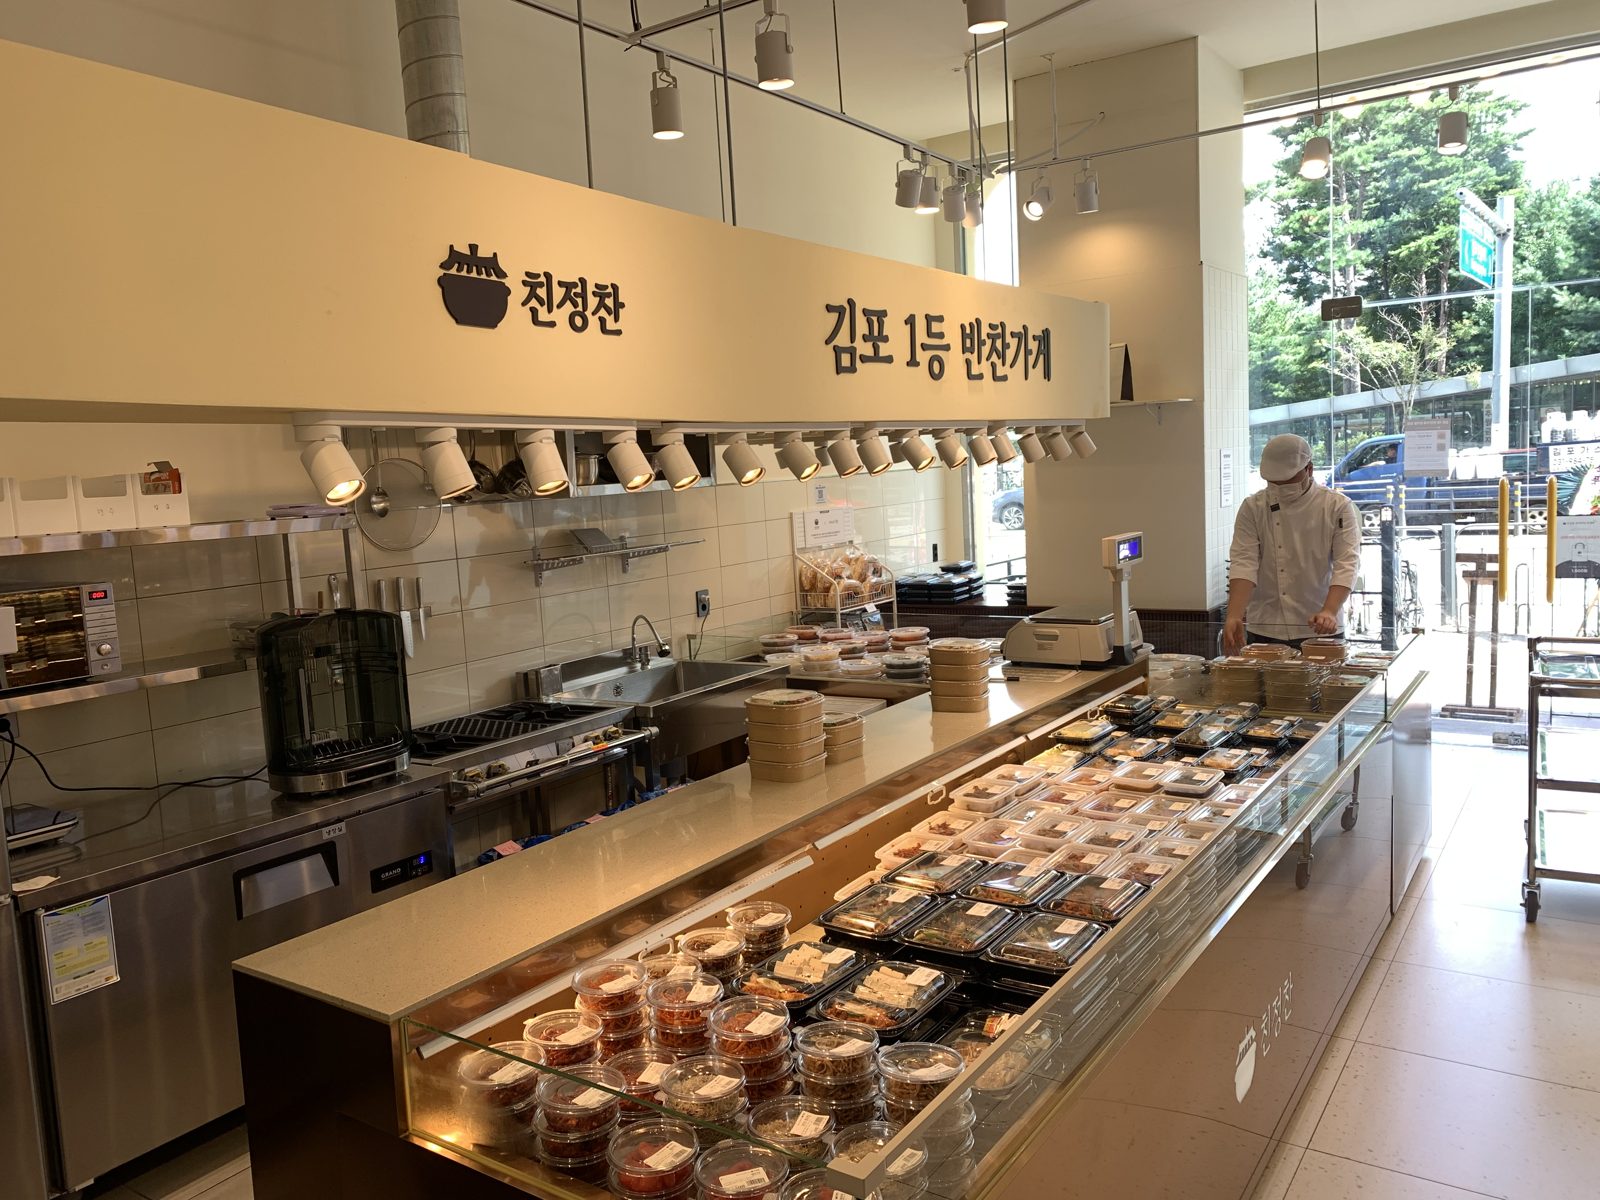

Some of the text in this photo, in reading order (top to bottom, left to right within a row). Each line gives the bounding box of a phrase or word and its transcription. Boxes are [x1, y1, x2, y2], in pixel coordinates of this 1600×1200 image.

[521, 270, 625, 336] 친정찬
[825, 297, 1052, 382] 김포 1등 반찬가게
[1260, 971, 1294, 1057] 친정찬
